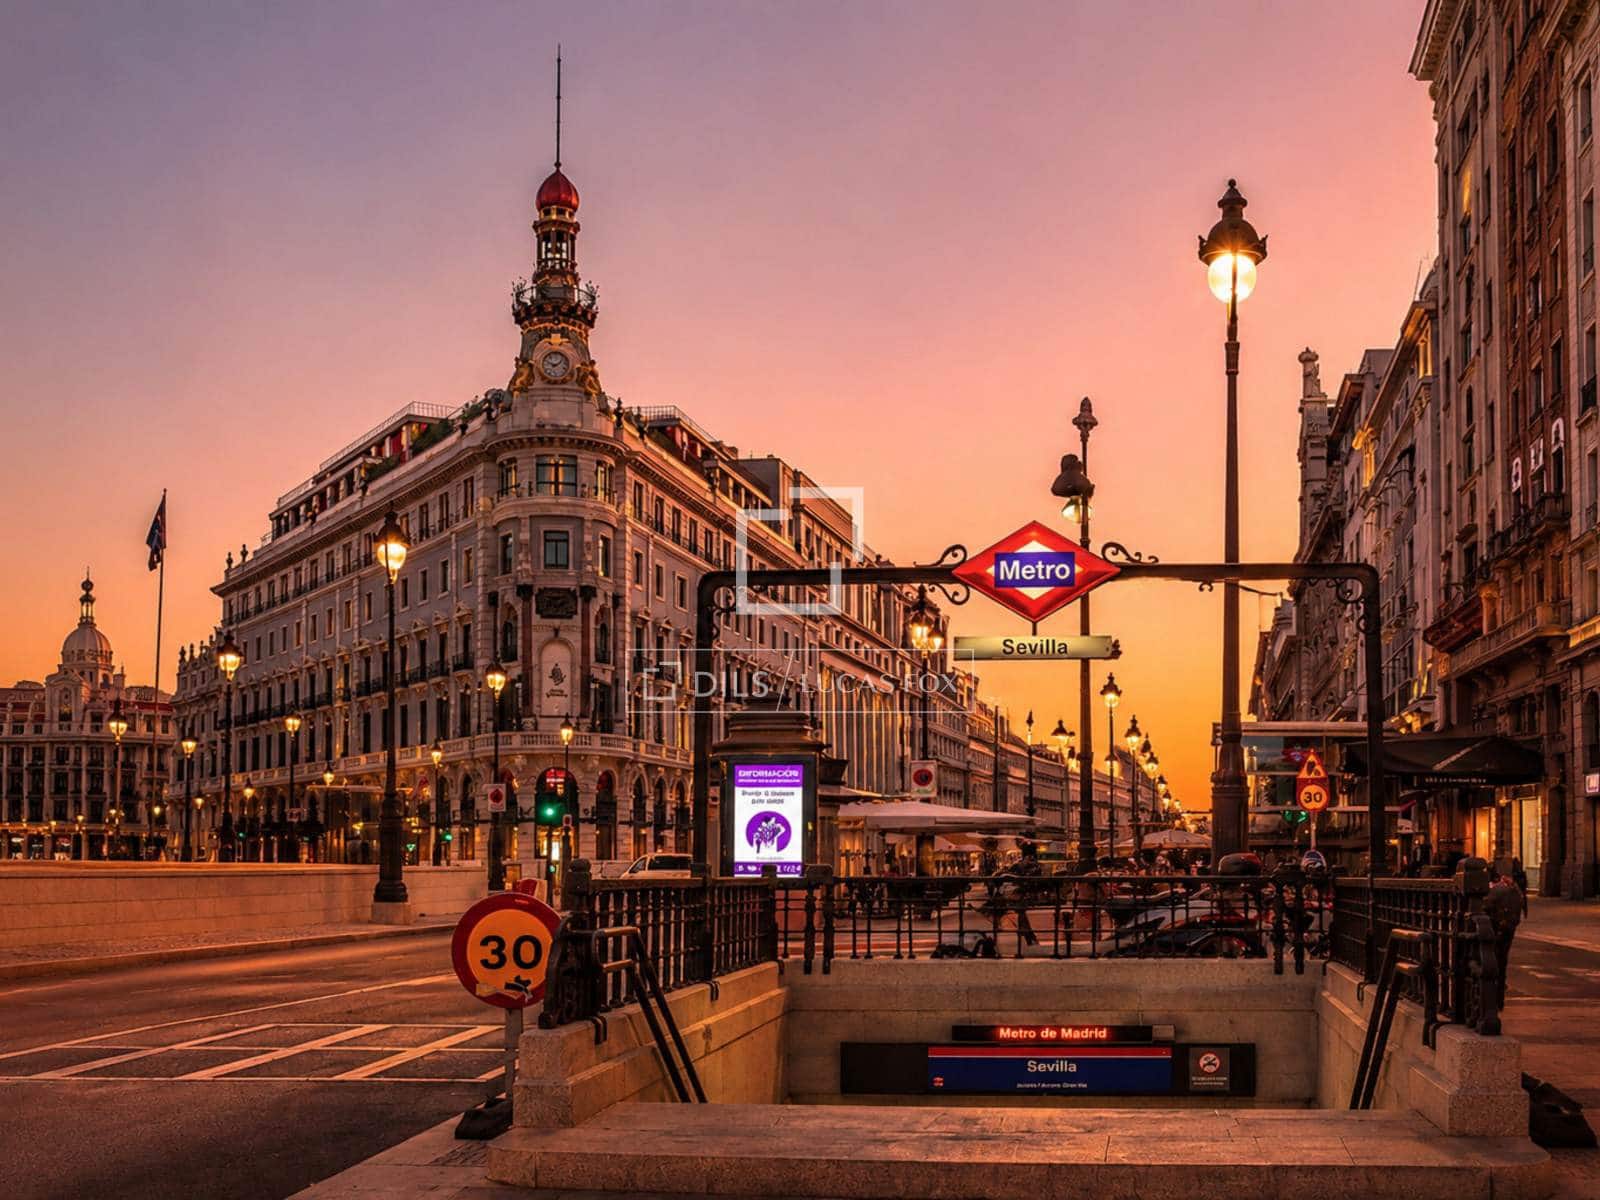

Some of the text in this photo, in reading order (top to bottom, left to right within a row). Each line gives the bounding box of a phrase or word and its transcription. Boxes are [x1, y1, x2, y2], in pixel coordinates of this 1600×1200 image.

[1000, 560, 1071, 580] Metro
[1002, 639, 1068, 655] Sevilla
[1303, 792, 1323, 804] 30
[479, 934, 543, 970] 30
[999, 1027, 1107, 1039] Metro de Madrid
[1027, 1060, 1077, 1073] Sevilla
